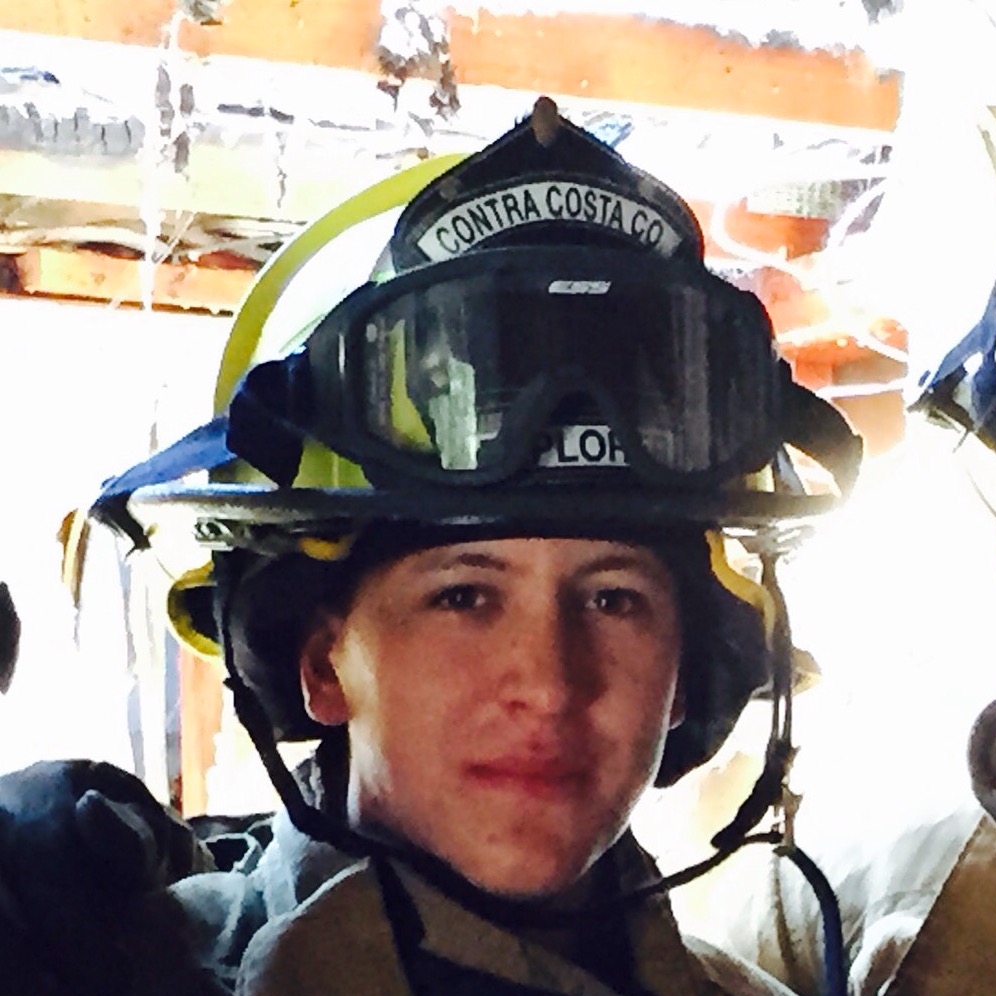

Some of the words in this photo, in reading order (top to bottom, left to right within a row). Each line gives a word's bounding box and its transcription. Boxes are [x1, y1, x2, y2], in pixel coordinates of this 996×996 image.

[436, 189, 542, 254] CONTRA
[545, 185, 624, 232] COSTA
[630, 210, 665, 248] CO
